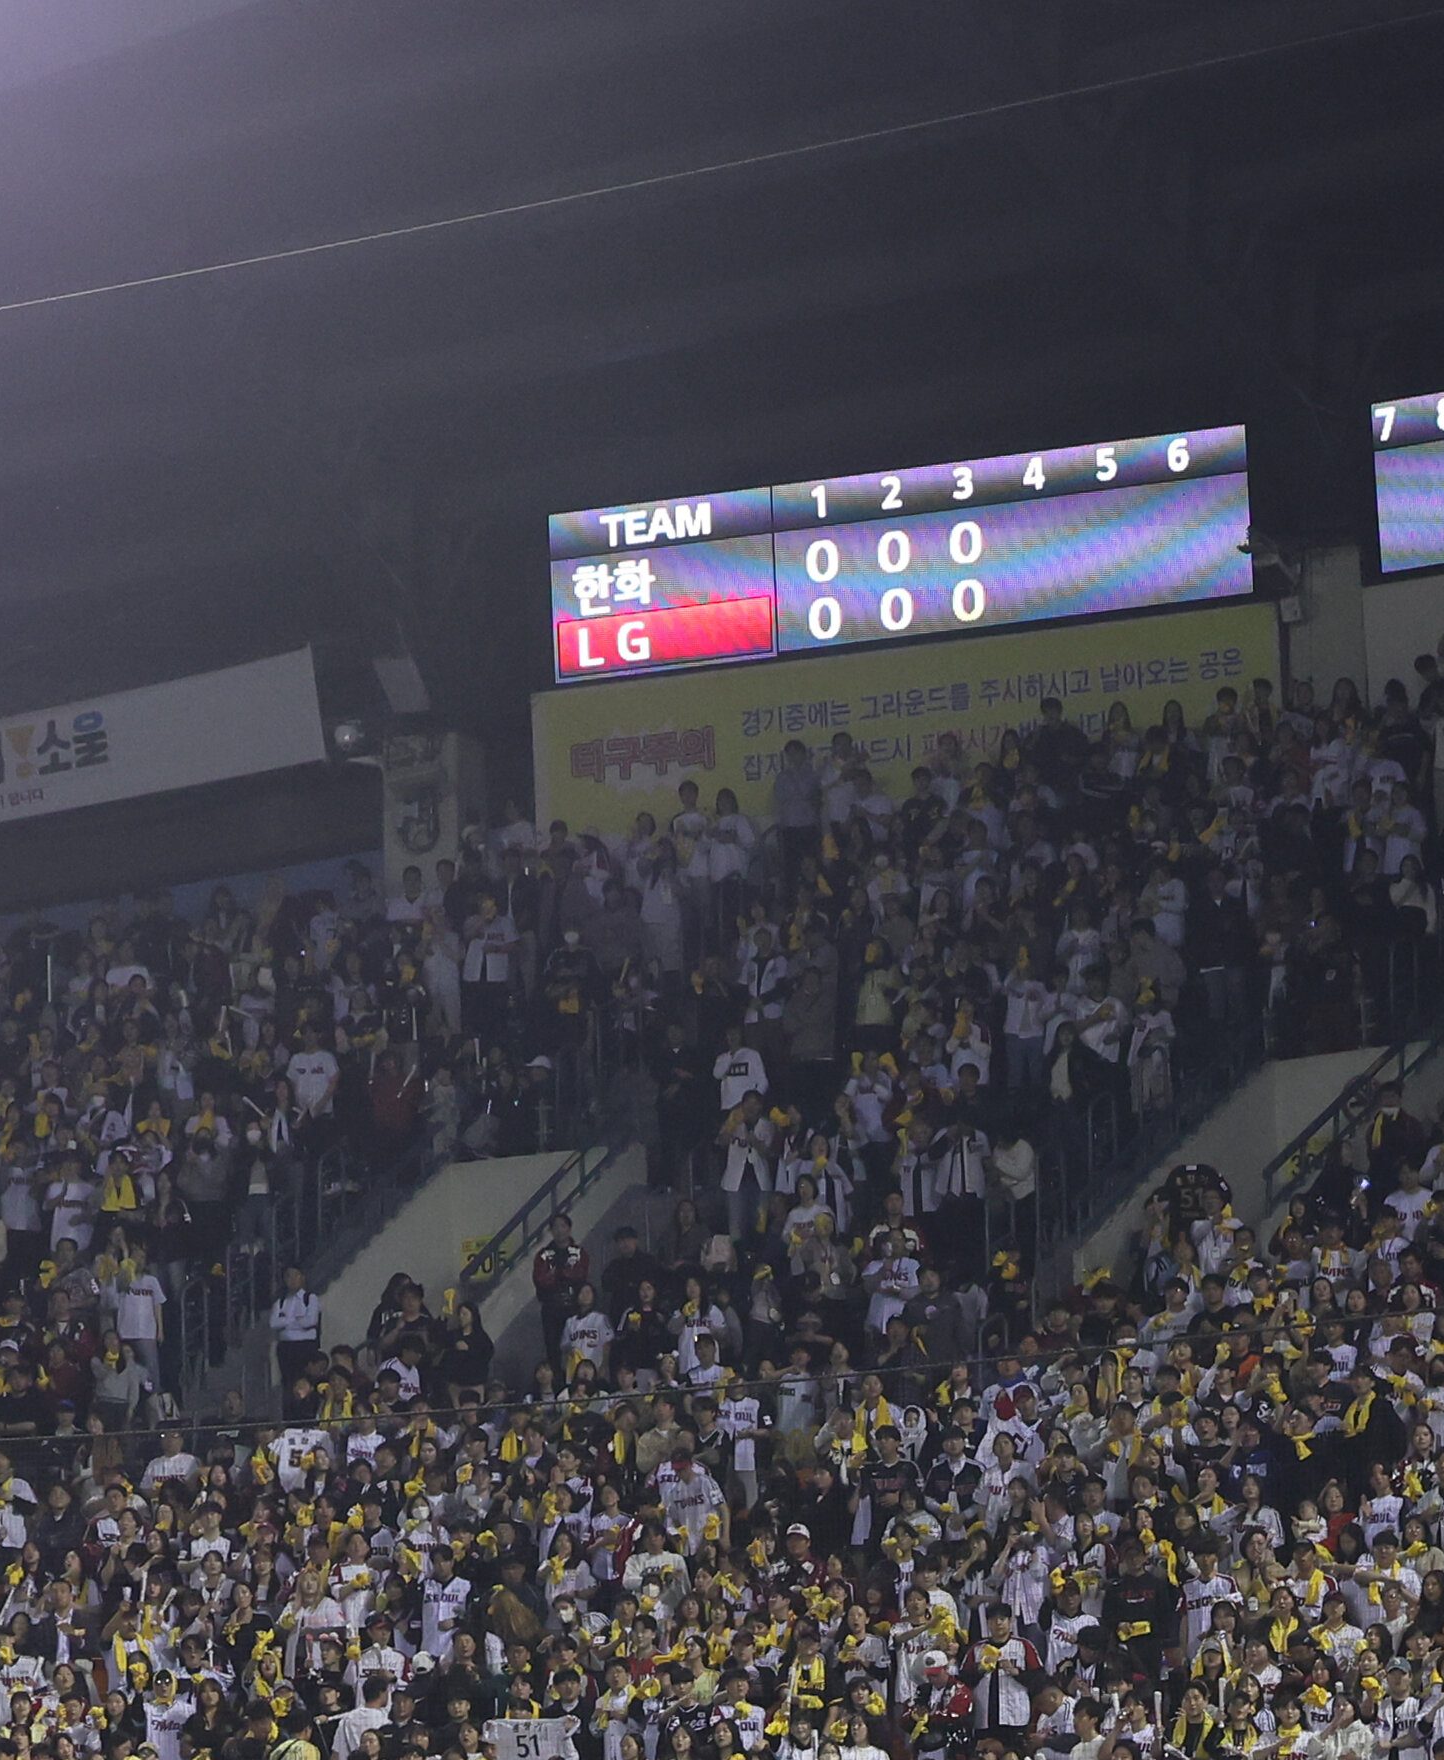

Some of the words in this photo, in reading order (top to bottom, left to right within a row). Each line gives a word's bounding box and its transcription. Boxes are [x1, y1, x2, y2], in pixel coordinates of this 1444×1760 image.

[1374, 407, 1396, 441] 7
[600, 503, 711, 547] TEAM
[811, 486, 827, 517] 1
[880, 478, 902, 510] 2
[952, 468, 974, 499] 3
[1022, 458, 1046, 490] 4
[1095, 449, 1117, 480] 5
[1167, 439, 1189, 471] 6
[572, 559, 655, 616] 한화
[806, 540, 839, 582] 0
[878, 531, 910, 573] 0
[949, 521, 982, 564] 0
[809, 597, 842, 639] 0
[881, 589, 912, 631] 0
[953, 579, 985, 621] 0
[742, 699, 851, 737] 경기중에는
[860, 681, 969, 722] 그라운드를
[979, 670, 1090, 706] 주시하시고
[1101, 657, 1189, 693] 날아오는
[1200, 648, 1243, 680] 공은
[517, 1734, 540, 1757] 51
